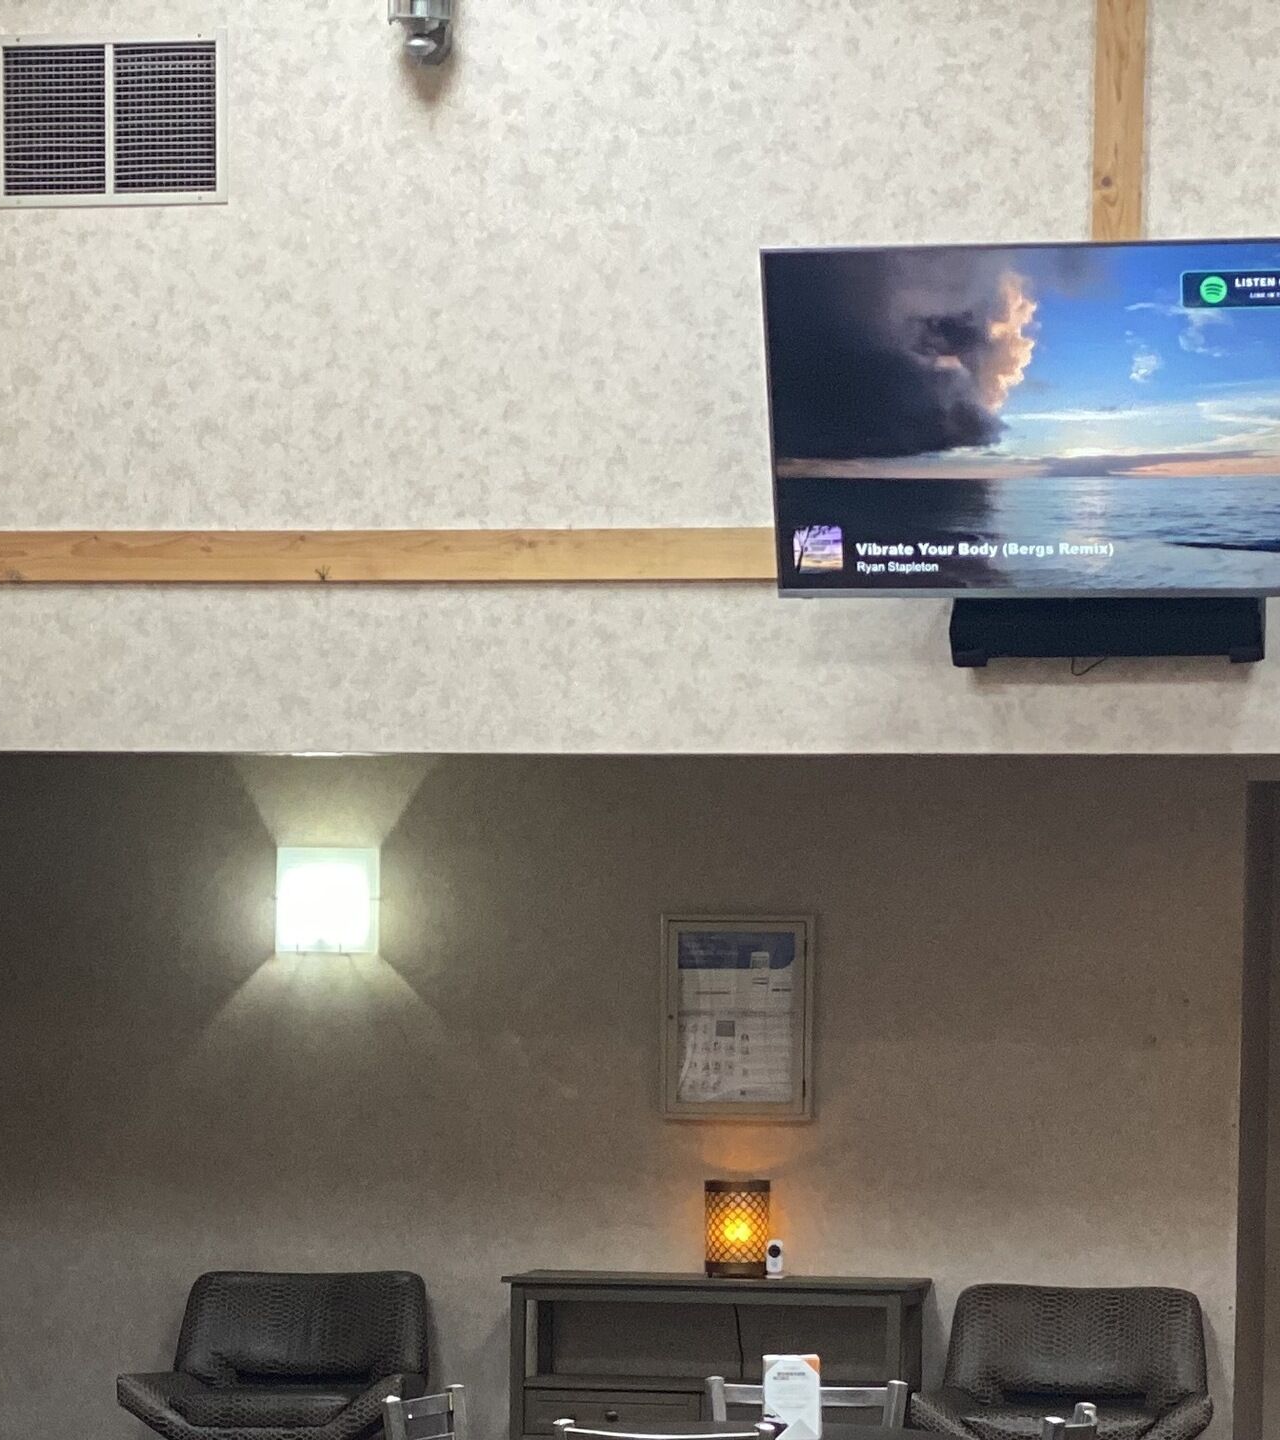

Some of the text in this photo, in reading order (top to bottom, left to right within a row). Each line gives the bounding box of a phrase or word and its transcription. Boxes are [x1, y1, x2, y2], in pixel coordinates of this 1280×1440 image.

[1235, 277, 1276, 287] LISTEN
[855, 542, 1114, 558] Vibrate Your Body (Bergs Remix)
[856, 560, 940, 574] Ryan Stapleton
